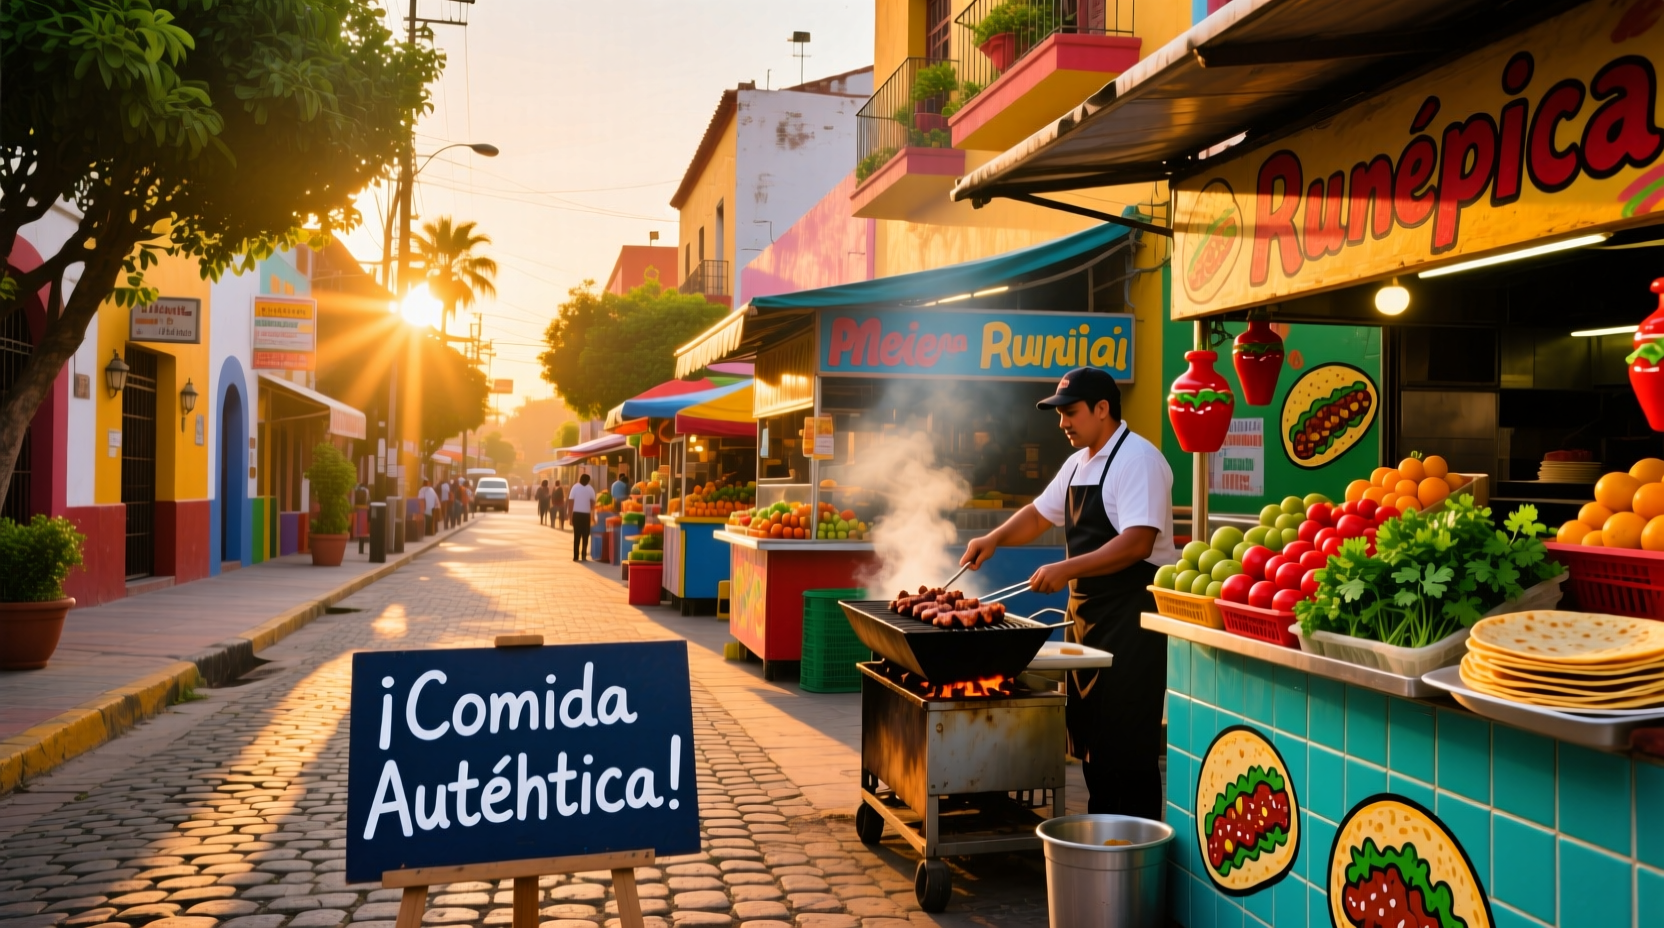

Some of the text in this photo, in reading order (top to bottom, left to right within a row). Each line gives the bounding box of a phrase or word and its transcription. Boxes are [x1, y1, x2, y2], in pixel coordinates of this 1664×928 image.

[1249, 51, 1664, 287] Runépica
[378, 661, 639, 751] ¡Comida
[363, 734, 682, 841] Autéhtica!
